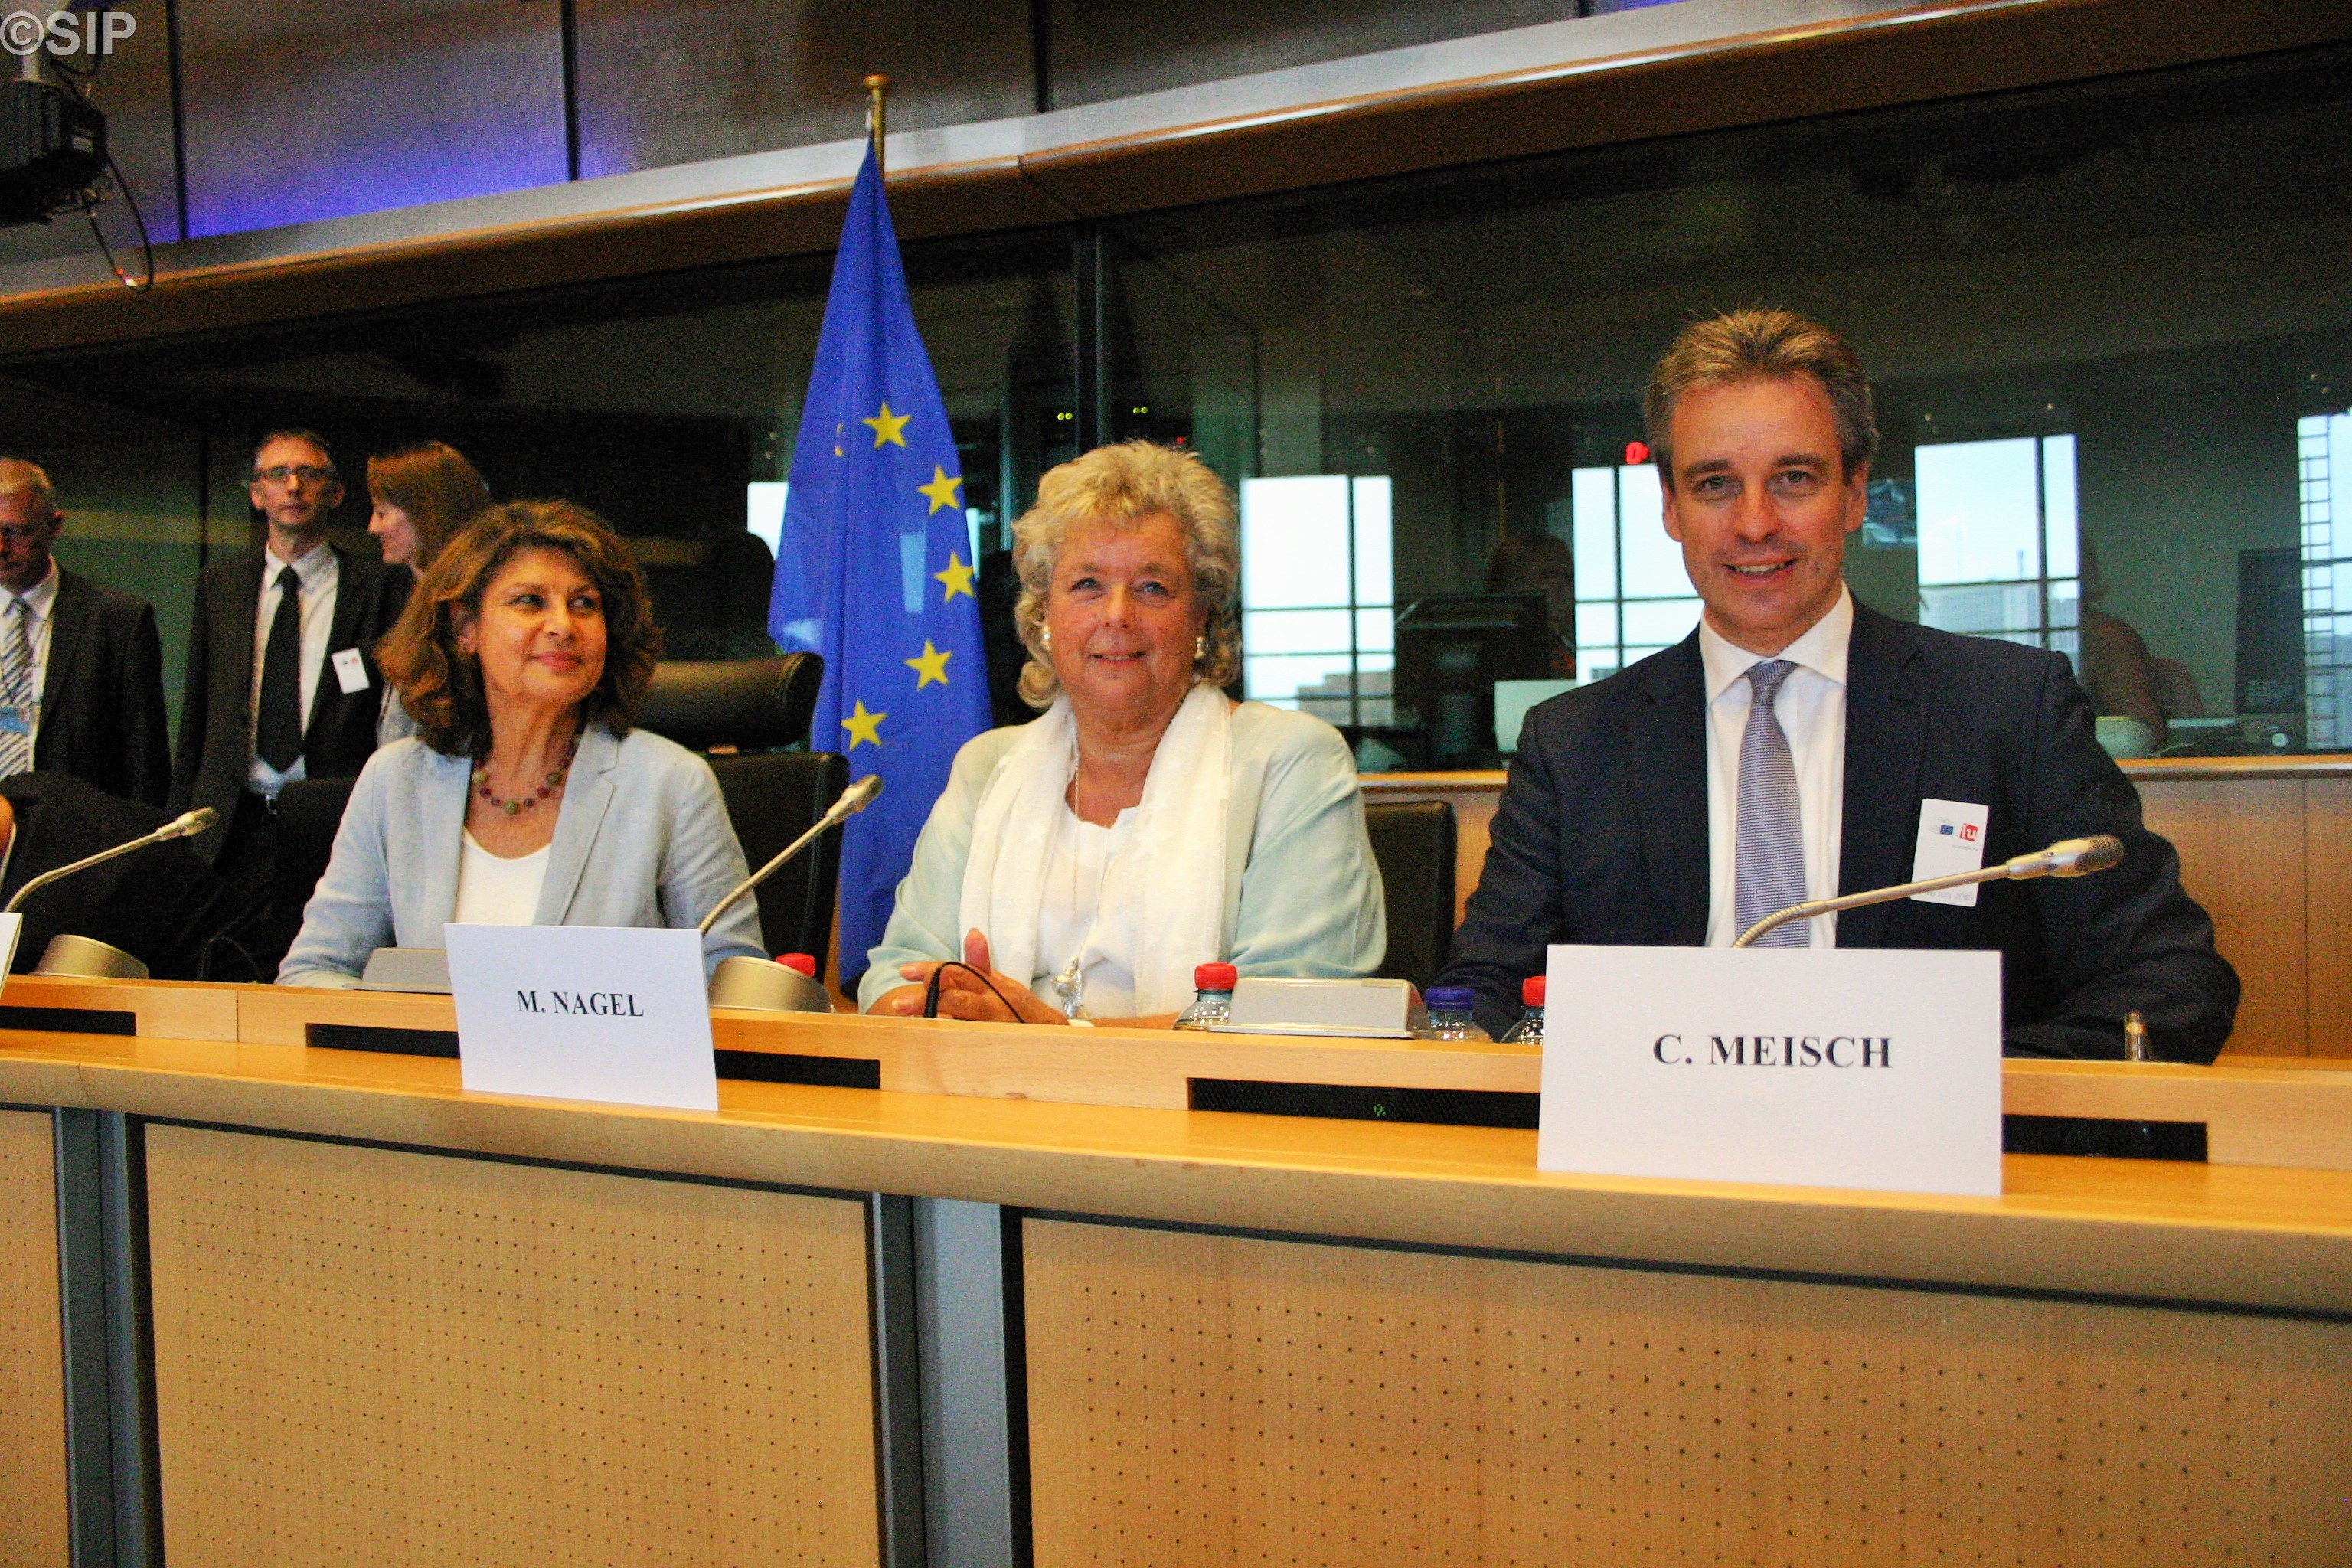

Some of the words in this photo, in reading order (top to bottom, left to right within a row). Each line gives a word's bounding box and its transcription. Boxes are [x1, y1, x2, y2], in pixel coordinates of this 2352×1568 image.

[516, 990, 546, 1013] M.
[551, 991, 645, 1017] NAGEL
[1653, 1034, 1693, 1065] C.
[1708, 1035, 1893, 1068] MEISCH
